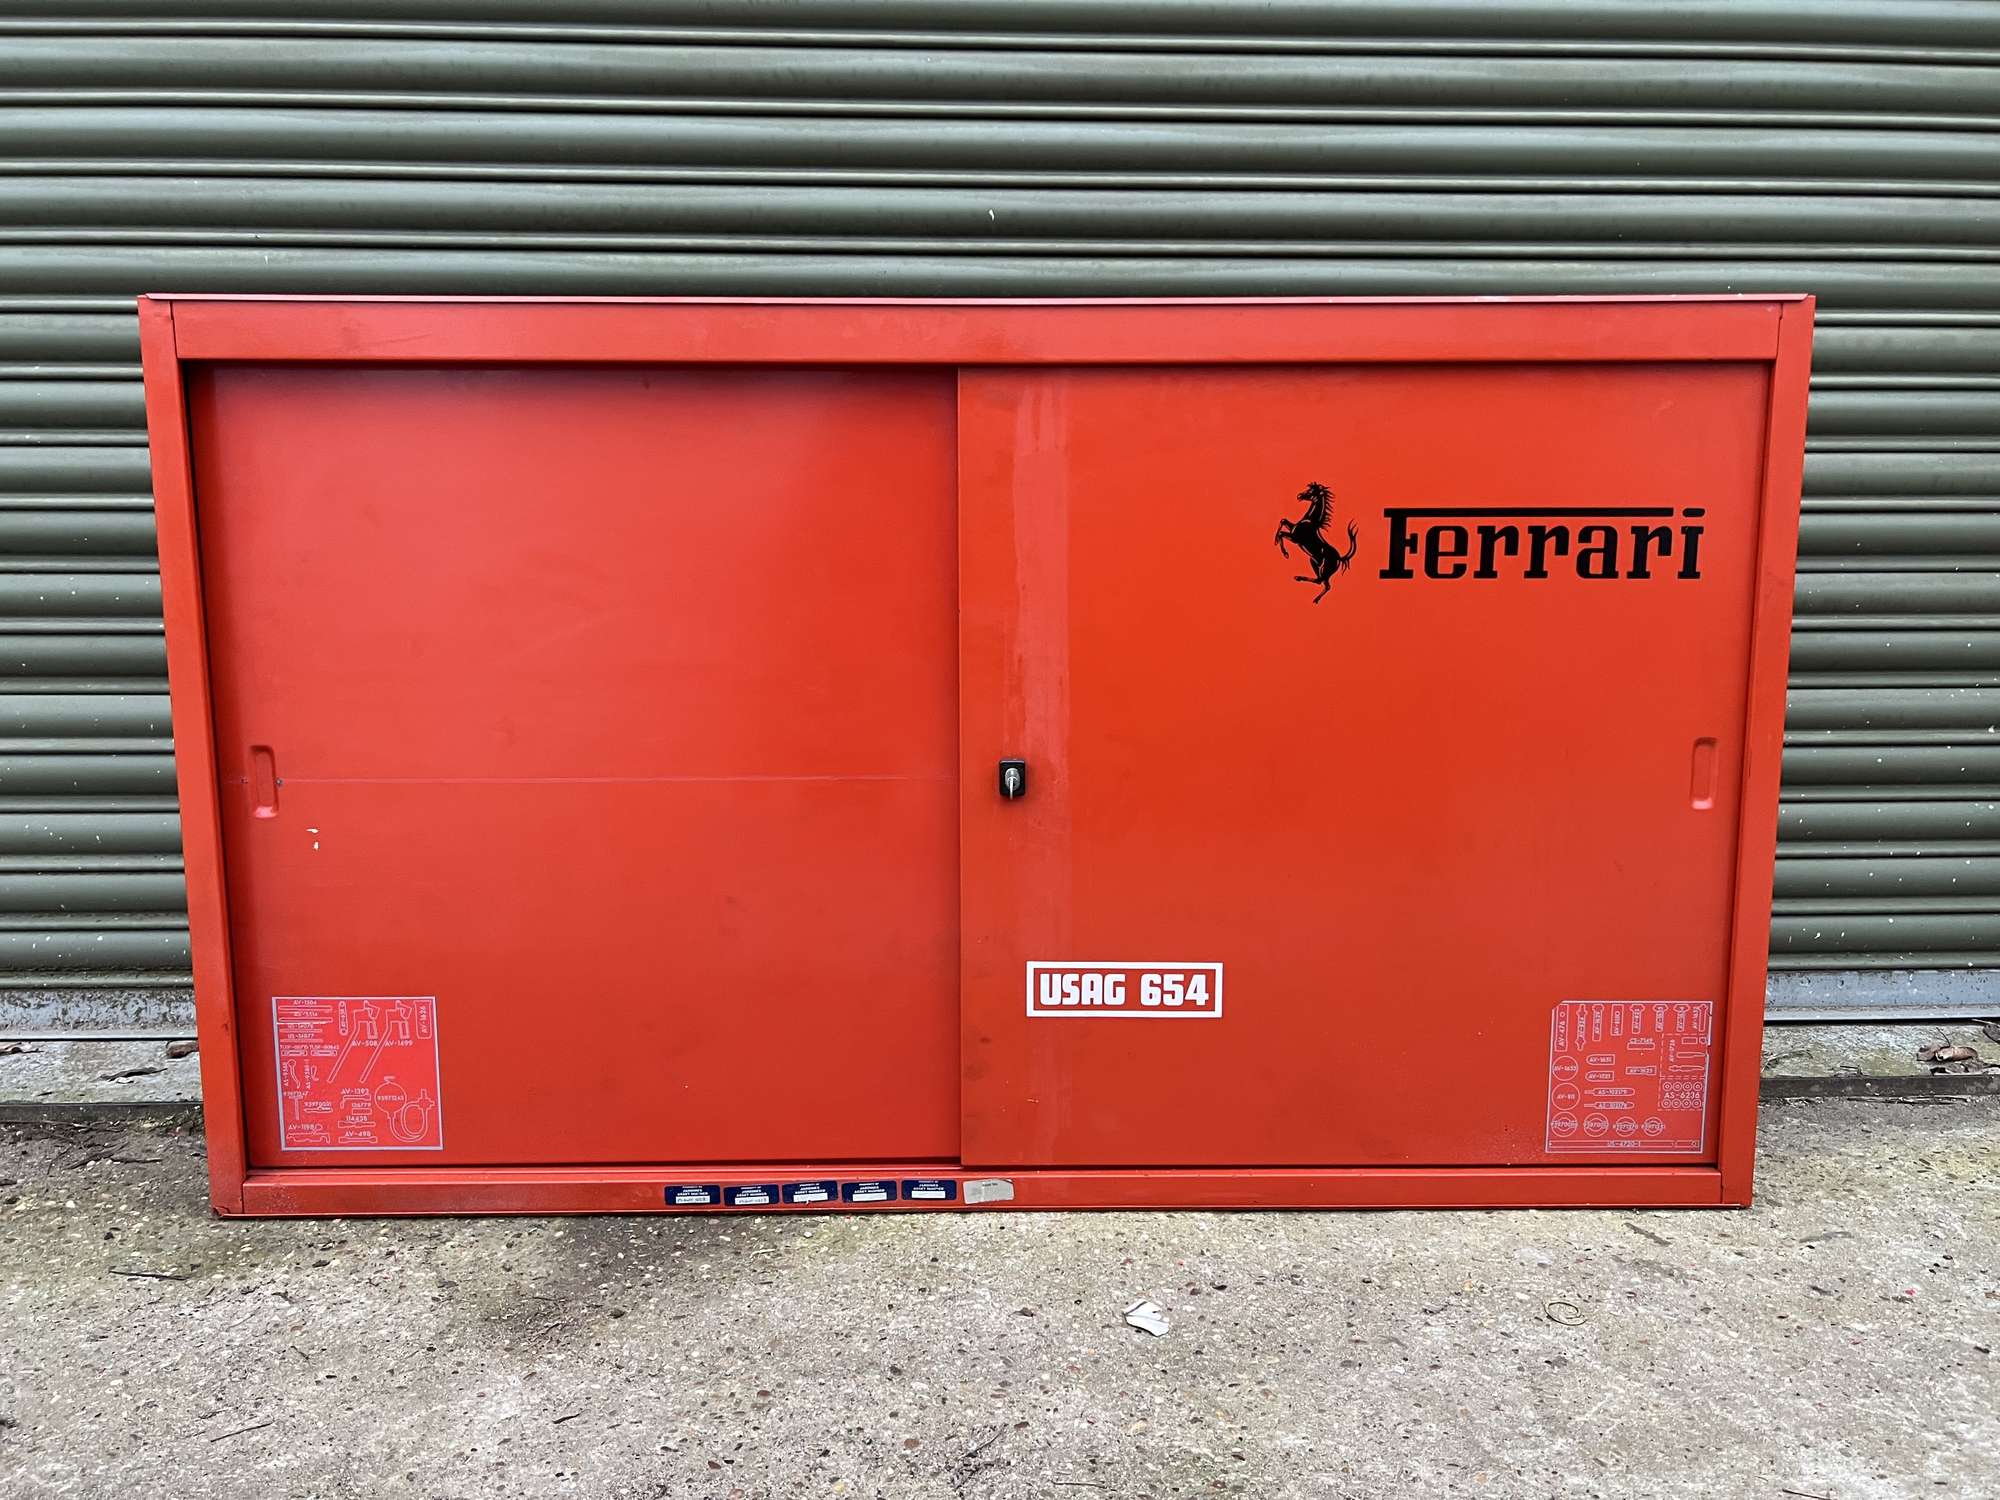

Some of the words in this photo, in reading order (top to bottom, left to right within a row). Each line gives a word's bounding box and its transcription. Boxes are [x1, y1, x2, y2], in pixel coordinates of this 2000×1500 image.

[1379, 507, 1706, 580] Ferrari
[1039, 973, 1126, 1006] USAG
[1140, 973, 1209, 1006] 654
